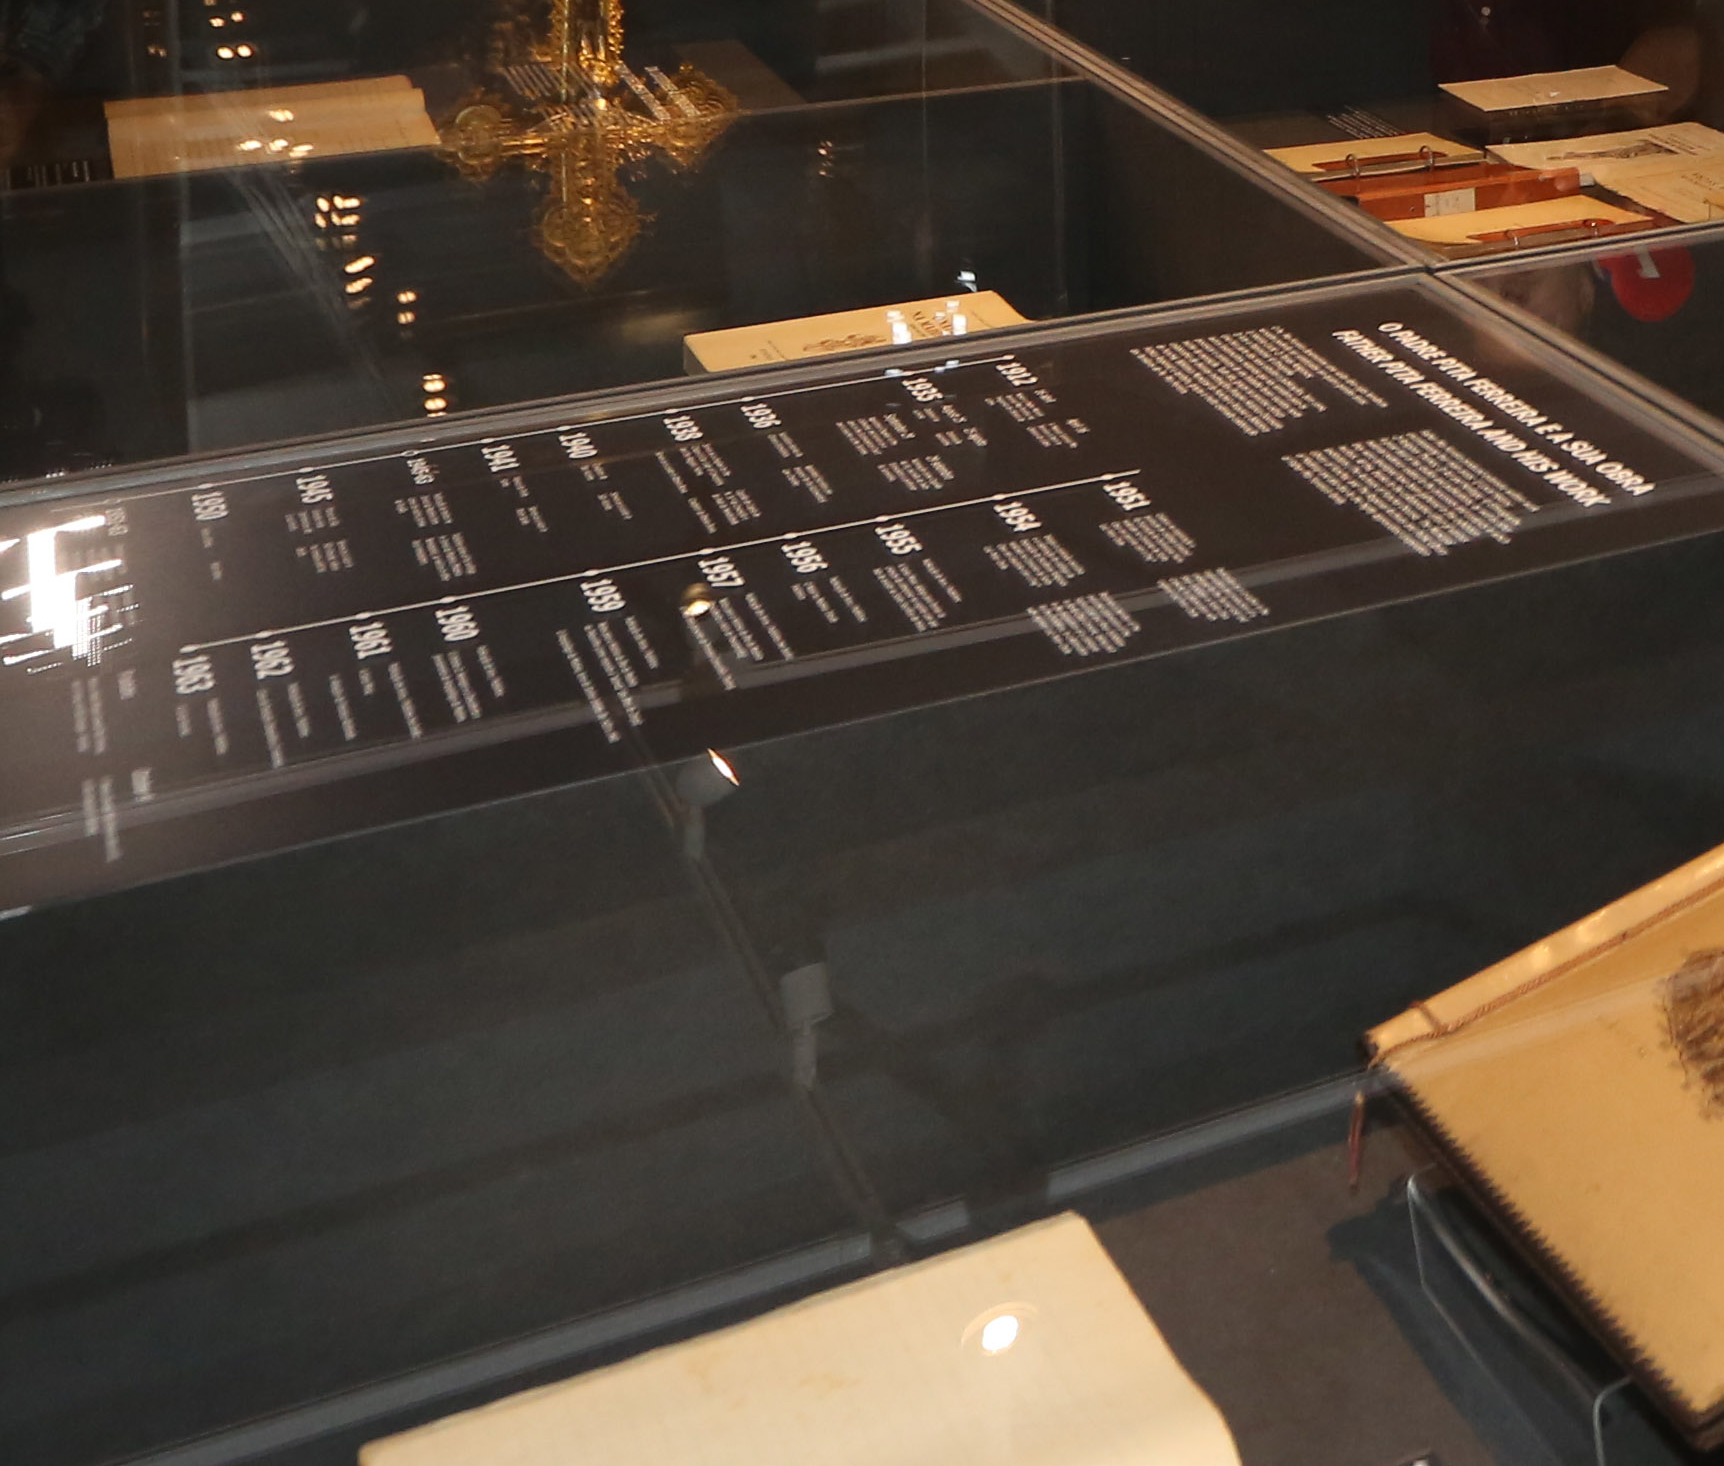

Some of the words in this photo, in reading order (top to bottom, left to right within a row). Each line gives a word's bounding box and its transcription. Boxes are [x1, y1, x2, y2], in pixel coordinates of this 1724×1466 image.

[1378, 322, 1403, 332] O
[1389, 329, 1447, 360] PADRE
[996, 362, 1038, 386] 1912
[1431, 357, 1478, 381] PITA
[902, 378, 943, 402] 1935
[1463, 378, 1548, 427] FERREIRA
[740, 403, 782, 429] 1936
[1332, 330, 1394, 363] FATHER
[1378, 360, 1425, 385] PITA
[1409, 382, 1494, 430] FERREIRA
[1477, 428, 1528, 452] AND
[1511, 449, 1560, 472] HIS
[1543, 469, 1611, 507] WORK
[1534, 423, 1563, 434] E
[559, 432, 599, 459] 1940
[1546, 433, 1574, 444] A
[1560, 440, 1608, 465] SUA
[481, 443, 520, 473] 1941
[296, 474, 334, 505] 1945
[1595, 461, 1656, 496] OBRA
[191, 490, 229, 521] 1950
[1102, 482, 1151, 512] 1951
[993, 501, 1041, 532] 1954
[875, 523, 923, 555] 1955
[698, 556, 745, 588] 1957
[780, 540, 828, 573] 1956
[580, 578, 626, 614] 1959
[435, 604, 481, 642] 1960
[349, 621, 393, 660] 1961
[172, 654, 216, 695] 1963
[250, 640, 296, 680] 1962
